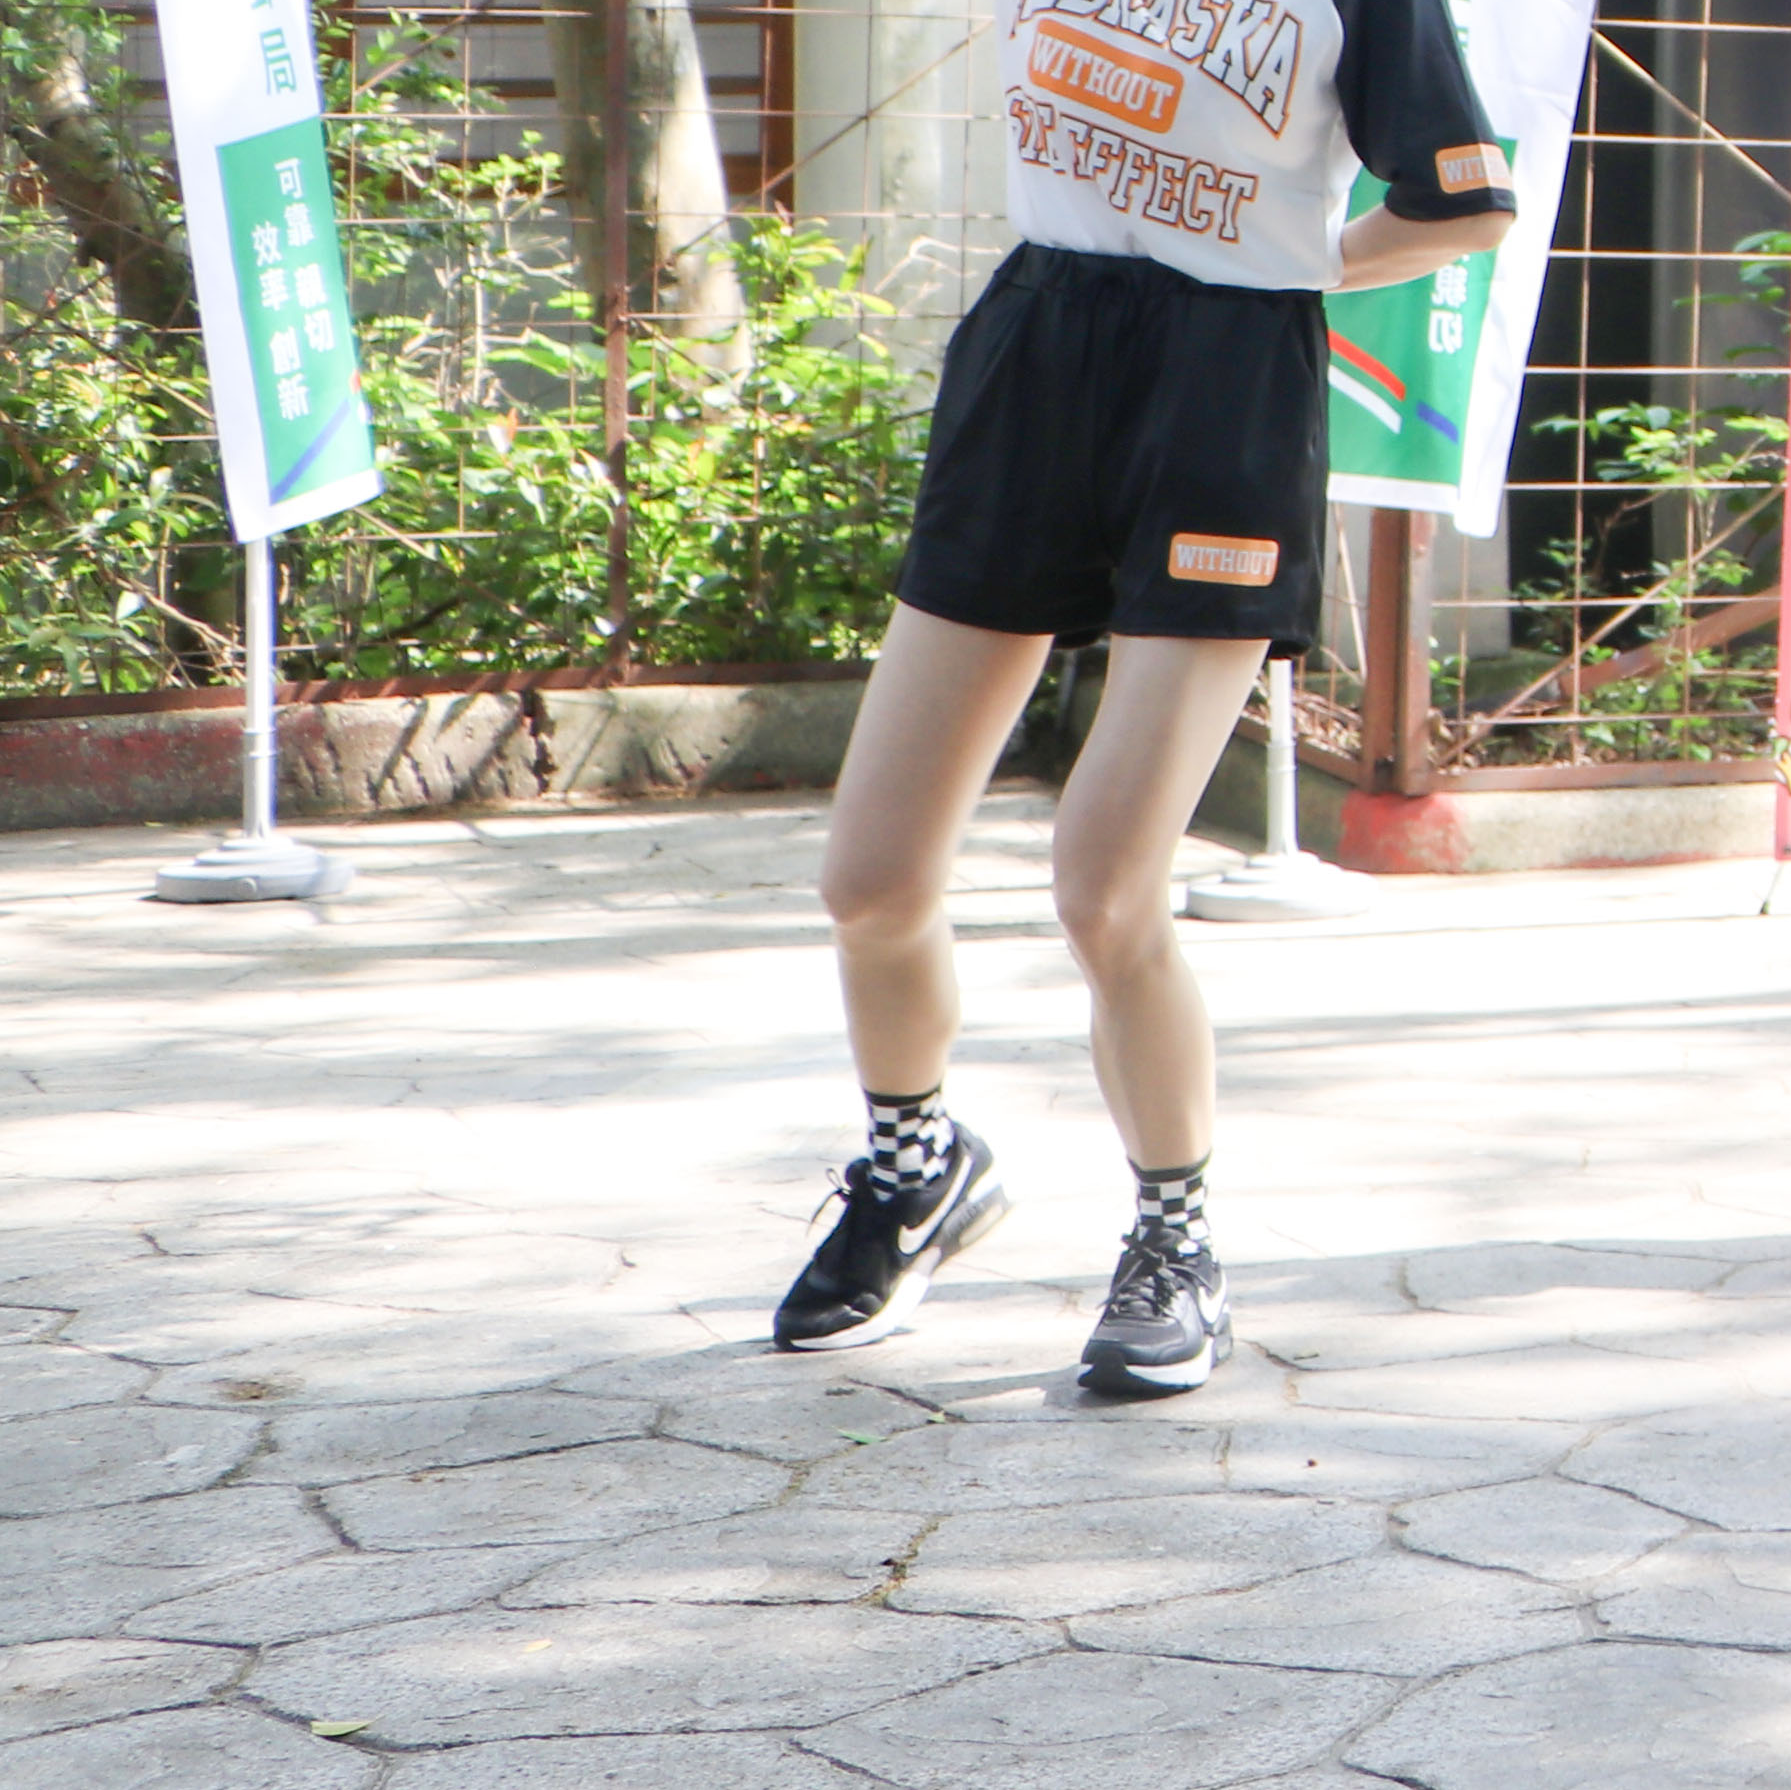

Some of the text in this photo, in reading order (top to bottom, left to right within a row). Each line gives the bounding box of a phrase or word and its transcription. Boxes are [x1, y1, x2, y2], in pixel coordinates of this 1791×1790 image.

[1031, 30, 1175, 121] WITHOUT
[251, 220, 309, 422] 效率 創新
[273, 157, 336, 354] 可靠 親切
[1174, 542, 1278, 577] WITHOUT
